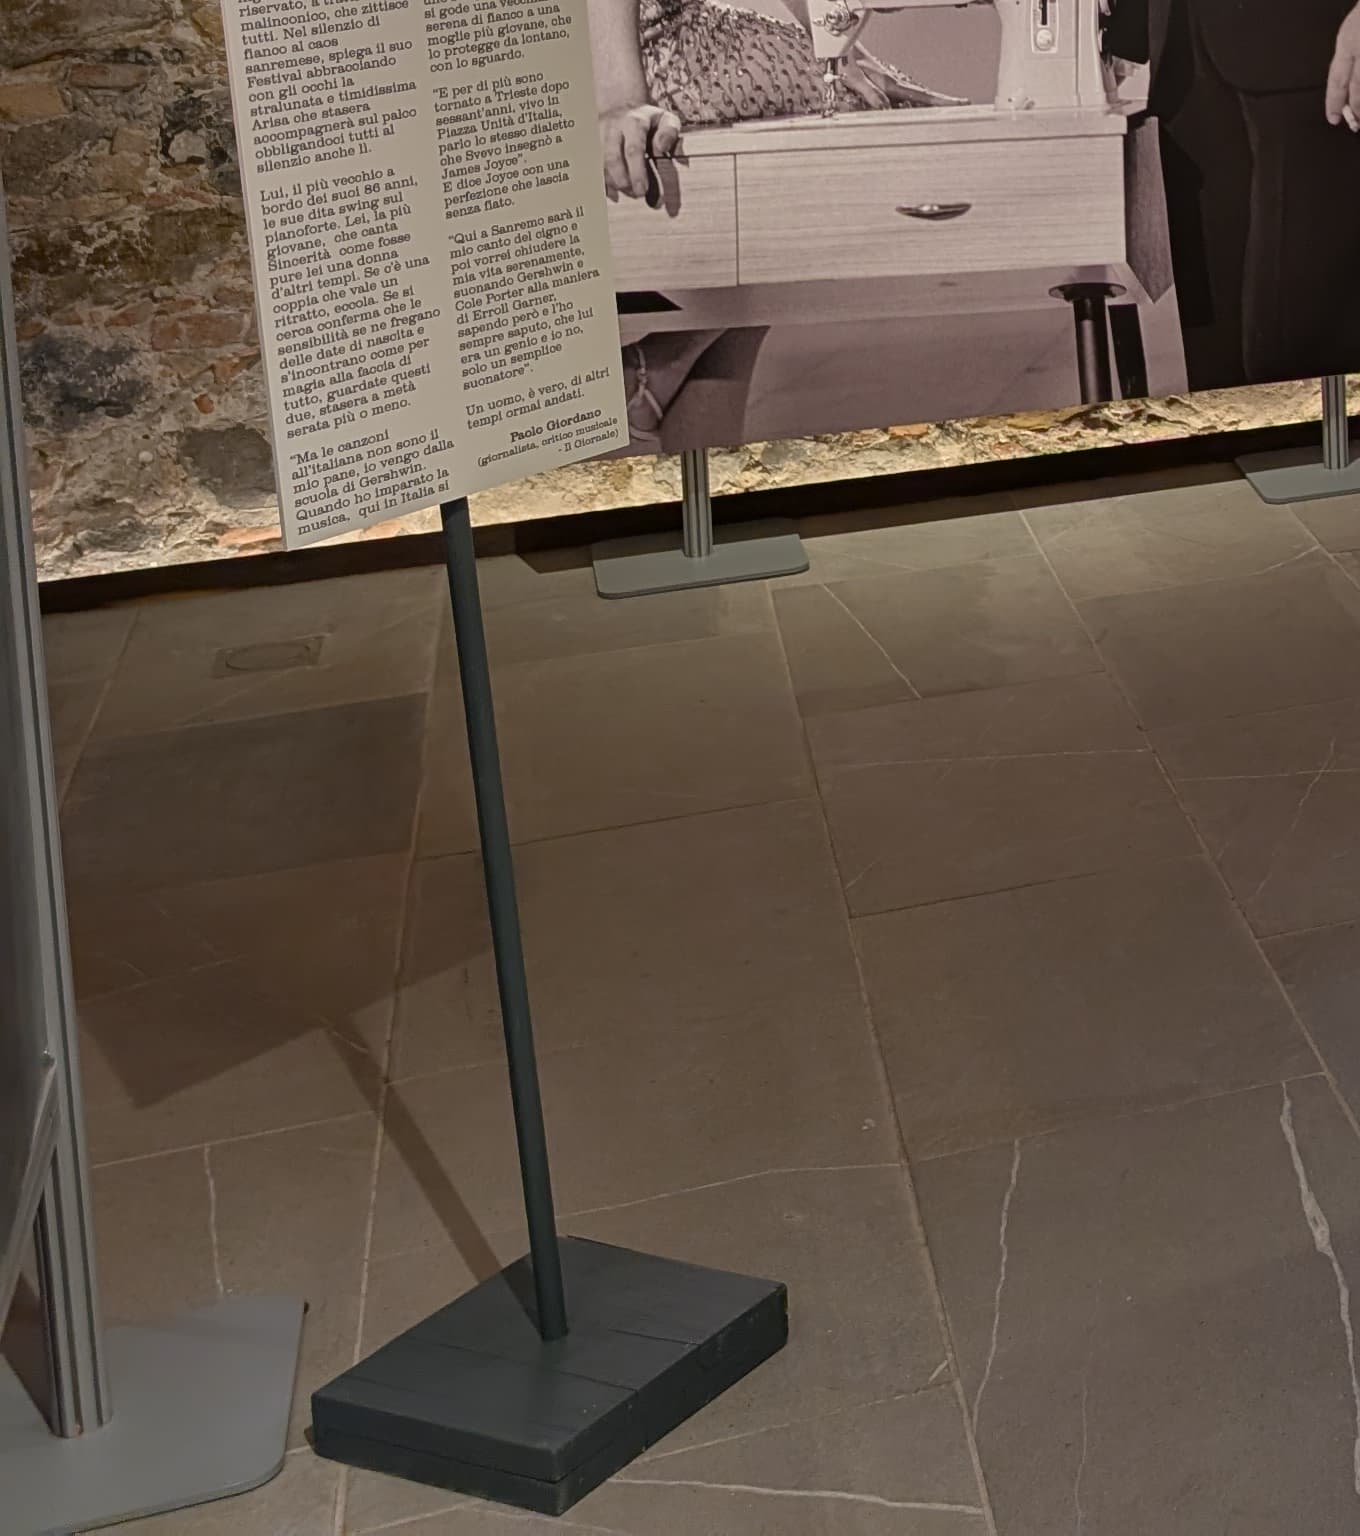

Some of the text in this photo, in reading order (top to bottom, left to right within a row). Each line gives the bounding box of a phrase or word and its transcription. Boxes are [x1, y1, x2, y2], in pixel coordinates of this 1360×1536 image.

[261, 198, 303, 215] bordo
[306, 192, 327, 206] dei
[331, 185, 360, 201] suoi
[363, 181, 380, 195] 86
[292, 183, 302, 195] il
[306, 178, 329, 195] più
[332, 169, 383, 187] vecchio
[386, 168, 395, 177] a
[466, 404, 484, 415] Un
[528, 387, 535, 398] è
[570, 375, 581, 387] di
[585, 367, 609, 383] altri
[467, 388, 584, 429] tempi ormai andati.
[510, 409, 601, 442] Paolo Giordano
[541, 431, 573, 446] critico
[575, 417, 617, 436] musicale
[564, 441, 571, 451] Il
[295, 468, 449, 524] Quando ho imparato la
[298, 479, 449, 534] musica, qui in Italia si
